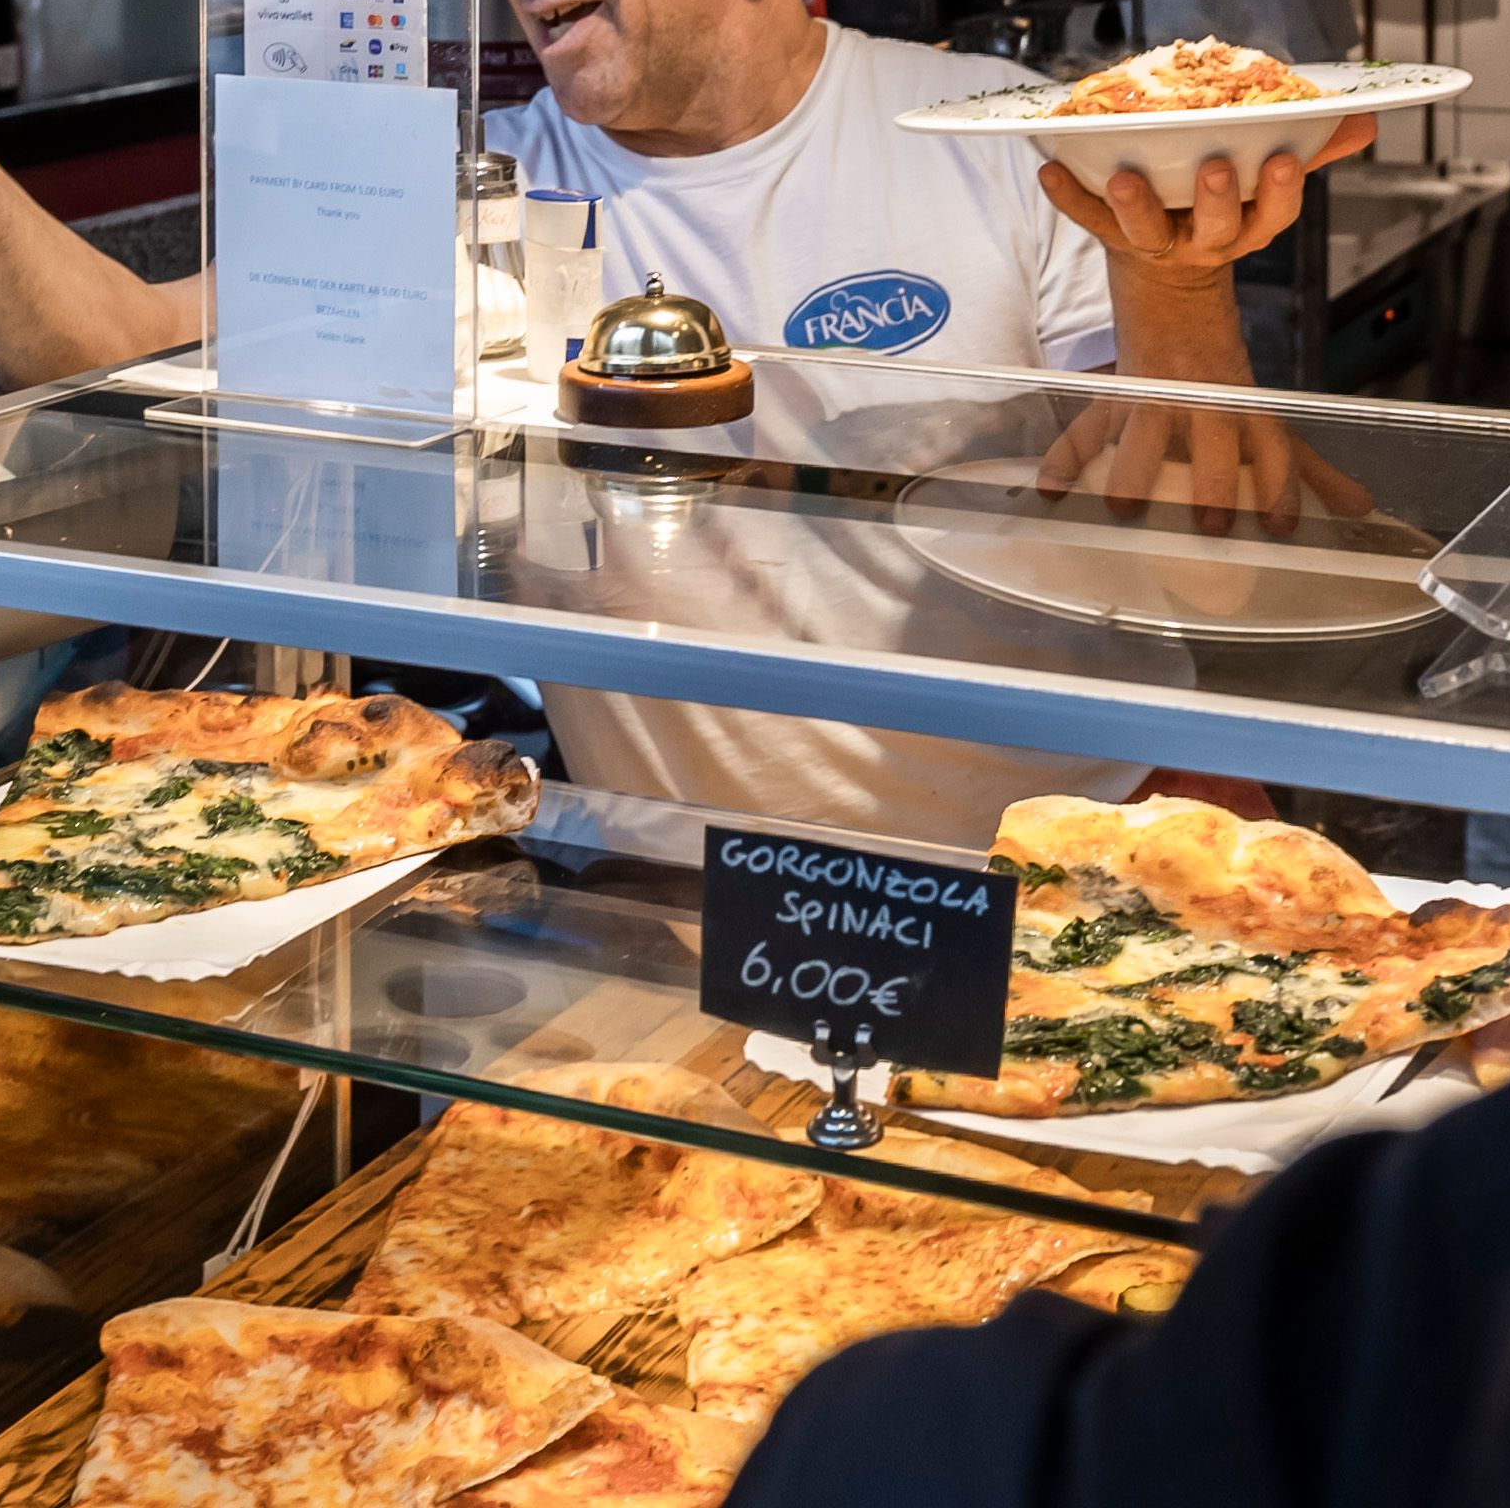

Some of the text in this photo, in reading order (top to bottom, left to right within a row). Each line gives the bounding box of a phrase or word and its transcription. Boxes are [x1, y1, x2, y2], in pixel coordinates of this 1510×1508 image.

[249, 175, 290, 189] PAYMENT
[304, 180, 327, 192] CARD
[329, 181, 357, 194] FROM
[378, 186, 404, 199] EURO
[317, 206, 361, 221] Thank you
[402, 288, 428, 302] EURO
[804, 287, 935, 345] FRANCIA
[343, 333, 365, 345] Dank
[721, 838, 990, 916] GORGONZOLA
[776, 891, 932, 949] SPINACI
[741, 941, 910, 1016] 6,00€
